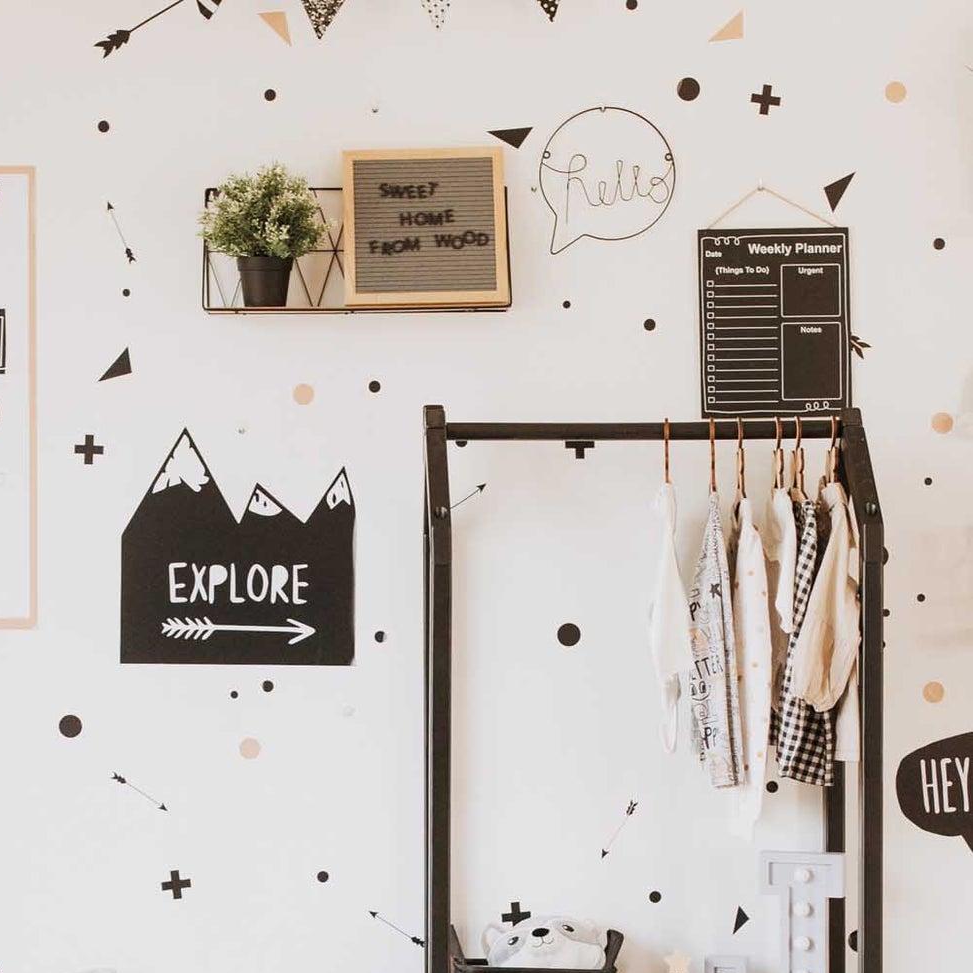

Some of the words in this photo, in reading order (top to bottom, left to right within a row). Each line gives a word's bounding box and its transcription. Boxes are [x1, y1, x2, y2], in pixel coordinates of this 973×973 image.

[379, 182, 438, 199] SWEET
[398, 209, 455, 226] HOME
[369, 237, 421, 256] FROM
[434, 230, 490, 250] WOOD
[747, 243, 792, 256] Weekly
[795, 242, 843, 254] Planner
[705, 250, 722, 258] Date
[745, 266, 755, 274] To
[798, 266, 824, 275] Urgent
[800, 325, 823, 334] Notes
[167, 561, 309, 606] EXPLORE
[919, 756, 970, 815] HEY
